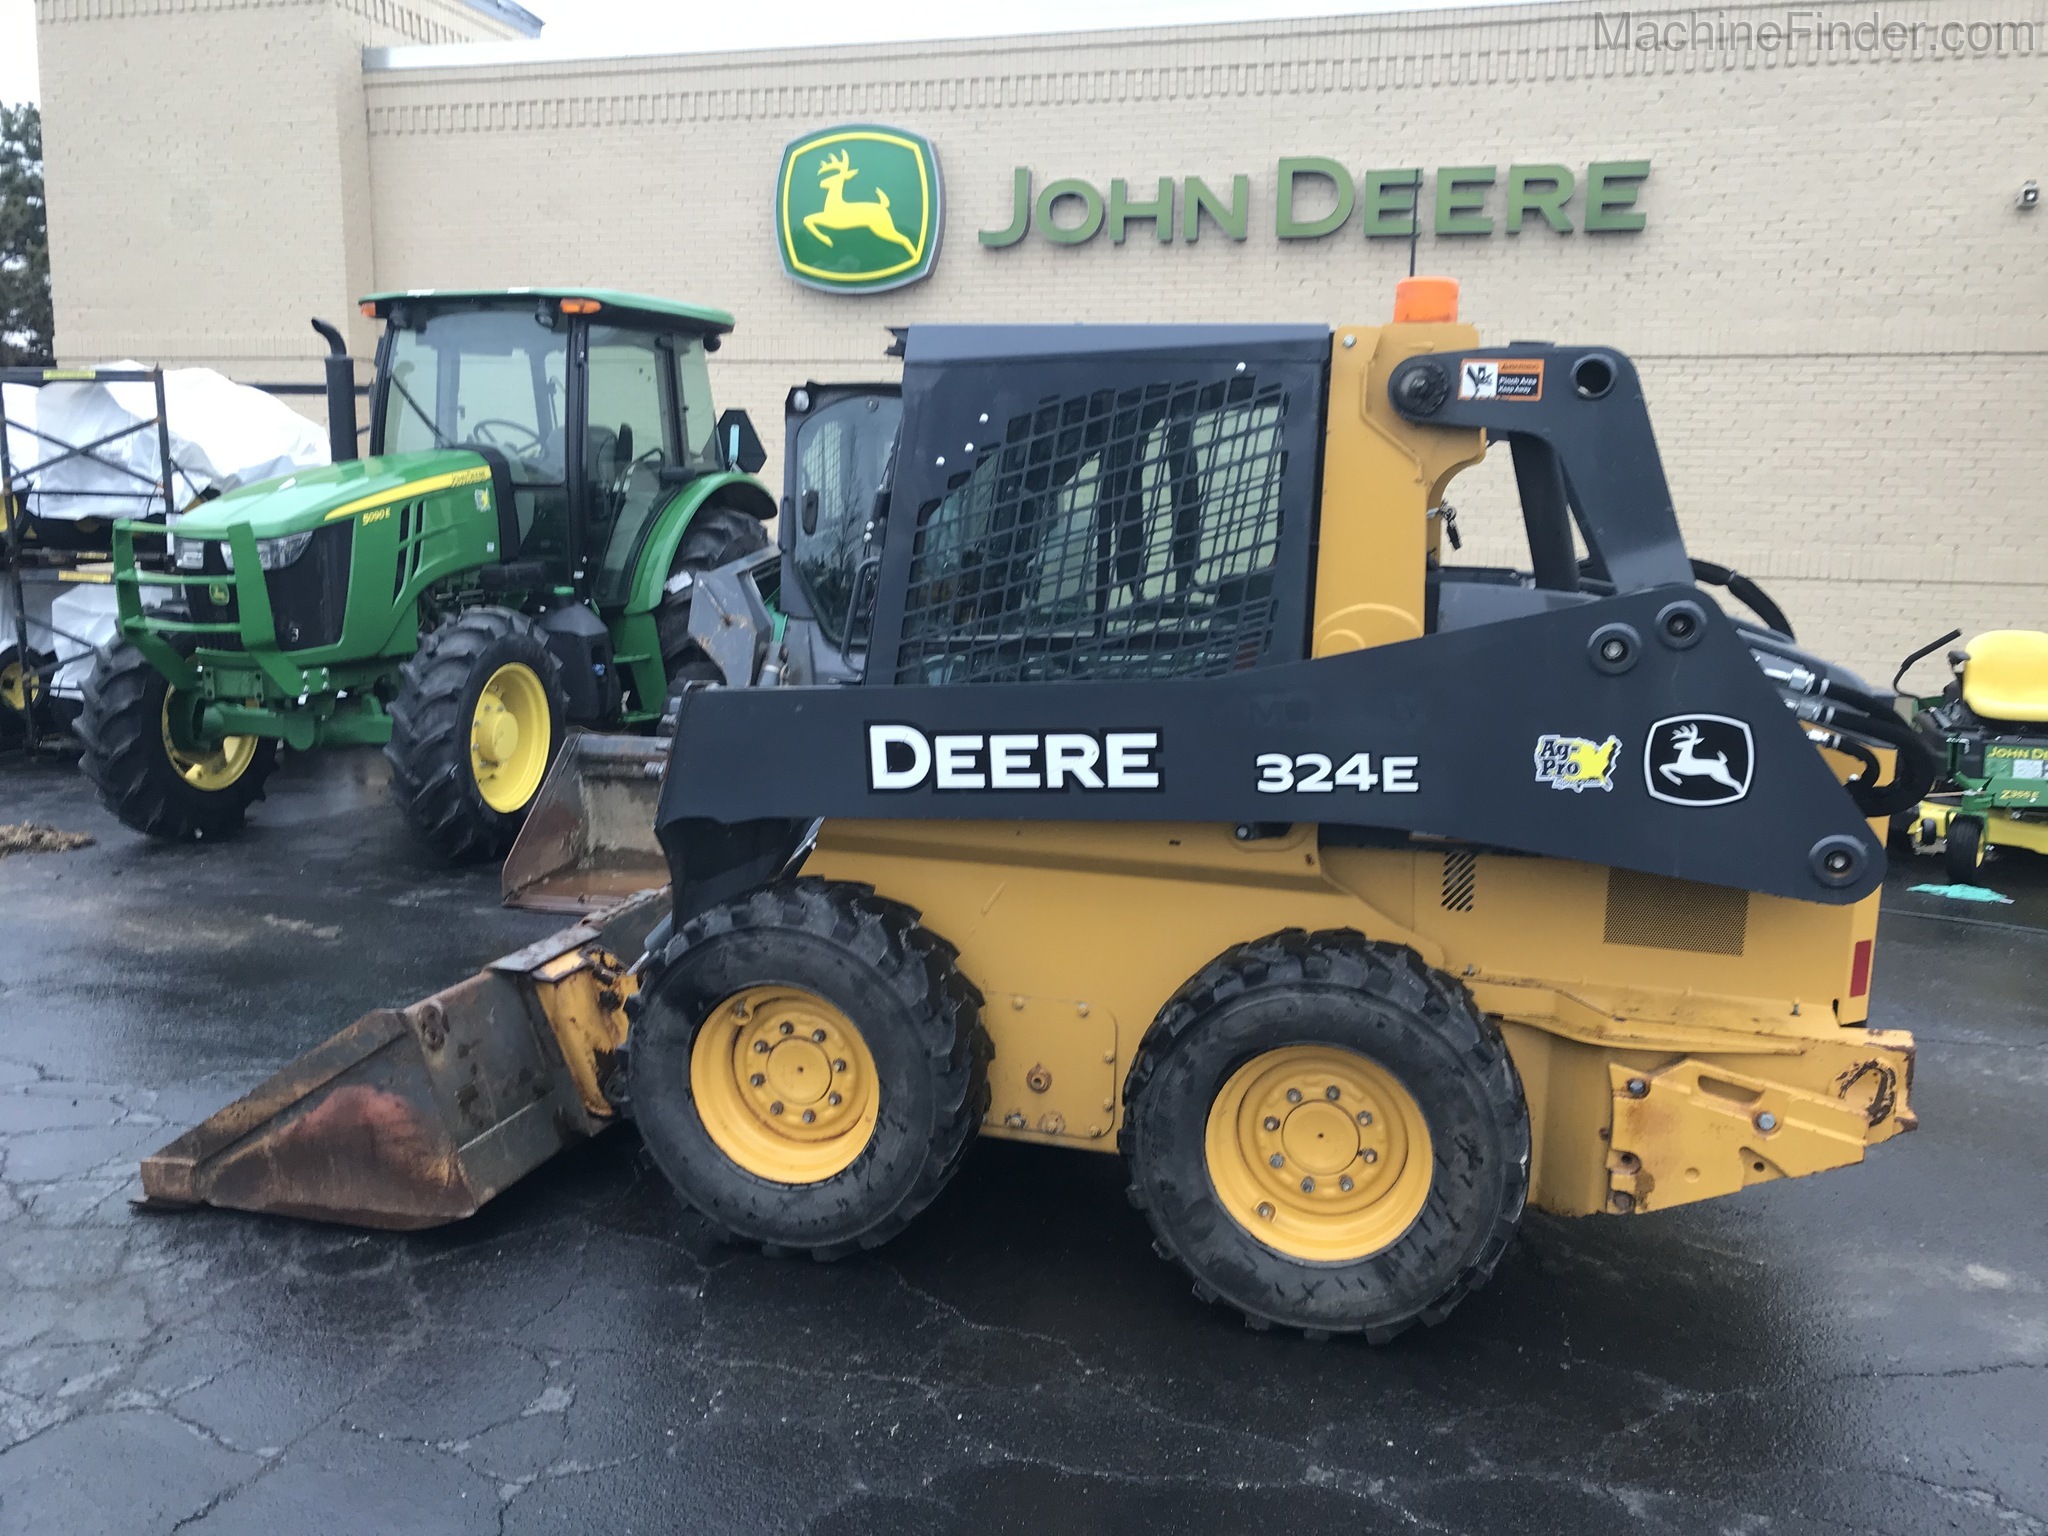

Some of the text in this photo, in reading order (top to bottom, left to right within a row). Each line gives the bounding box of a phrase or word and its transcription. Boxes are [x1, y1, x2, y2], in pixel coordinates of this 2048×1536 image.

[978, 156, 1652, 248] JOHN DEERE
[869, 724, 1159, 790] DEERE
[1540, 740, 1578, 761] Ag-
[1987, 746, 2029, 758] JOHN
[1255, 752, 1420, 793] 324E
[1541, 759, 1580, 776] Pro
